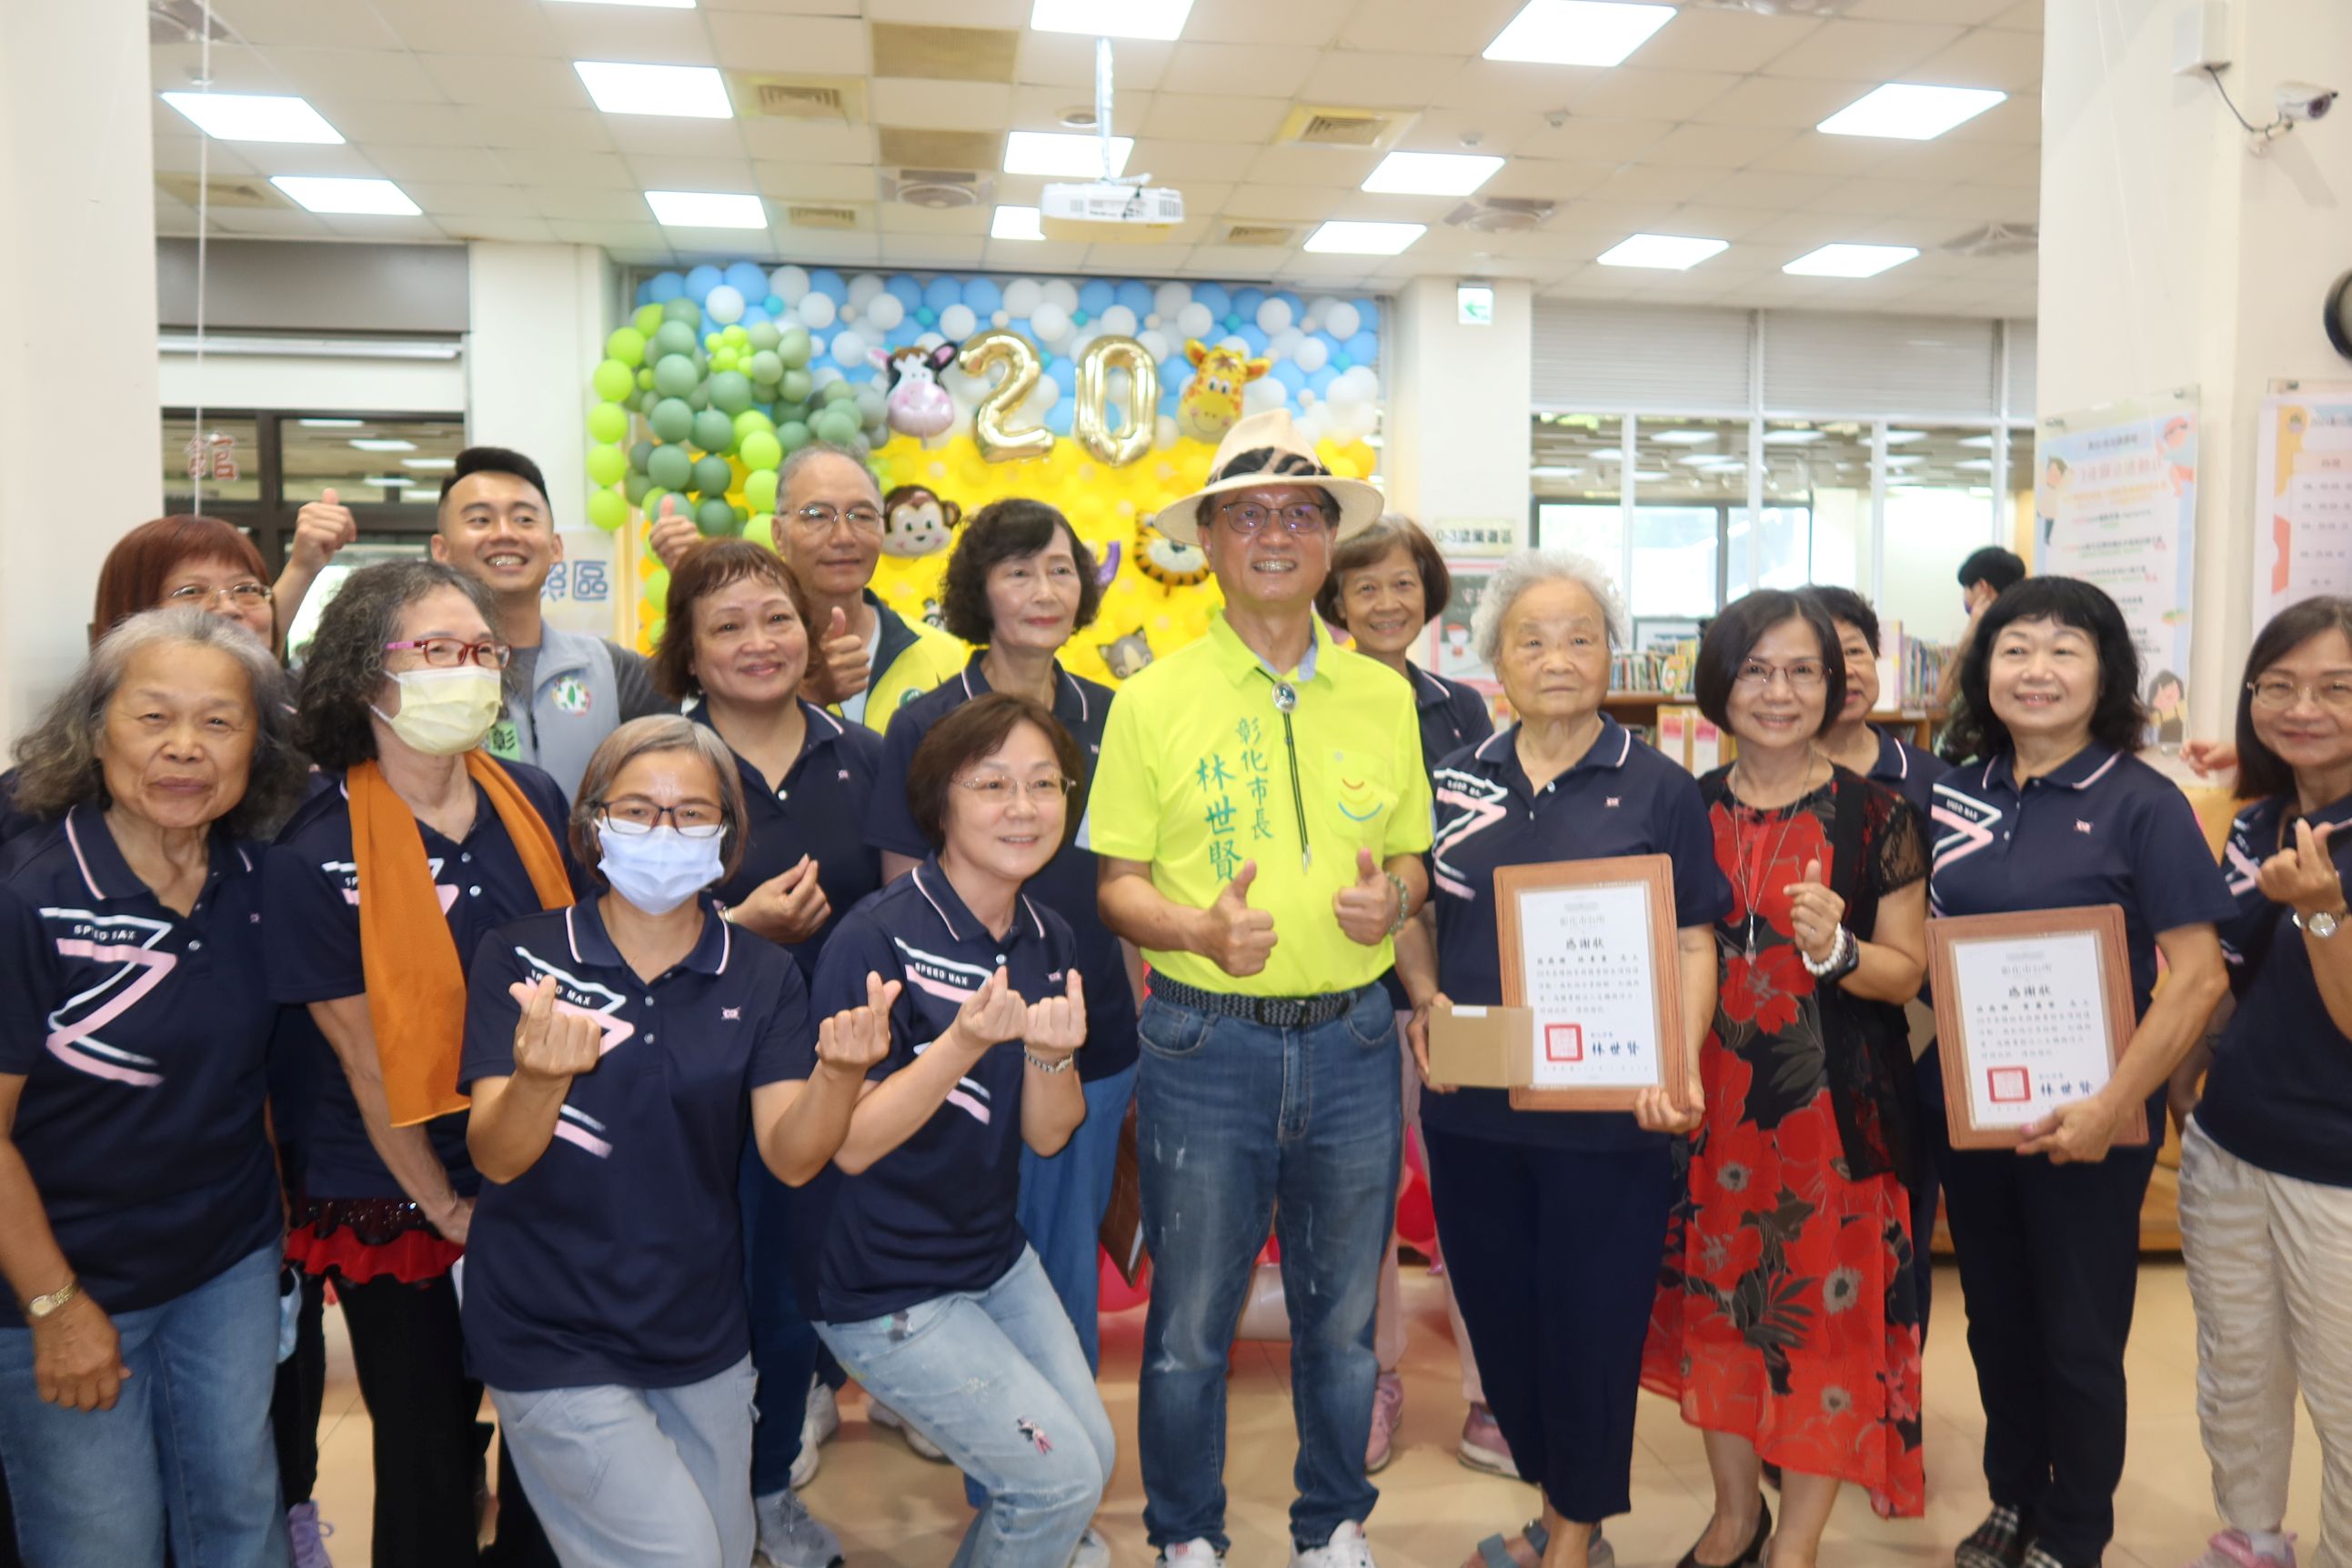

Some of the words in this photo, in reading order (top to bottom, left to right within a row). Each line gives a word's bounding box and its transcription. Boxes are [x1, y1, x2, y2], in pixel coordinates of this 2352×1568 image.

[959, 329, 1158, 467] 20
[1196, 753, 1242, 883] 林世賢
[1235, 717, 1273, 840] 彰化市長
[566, 989, 591, 1007] MAX
[914, 961, 946, 980] SPEED
[948, 972, 969, 988] MAX
